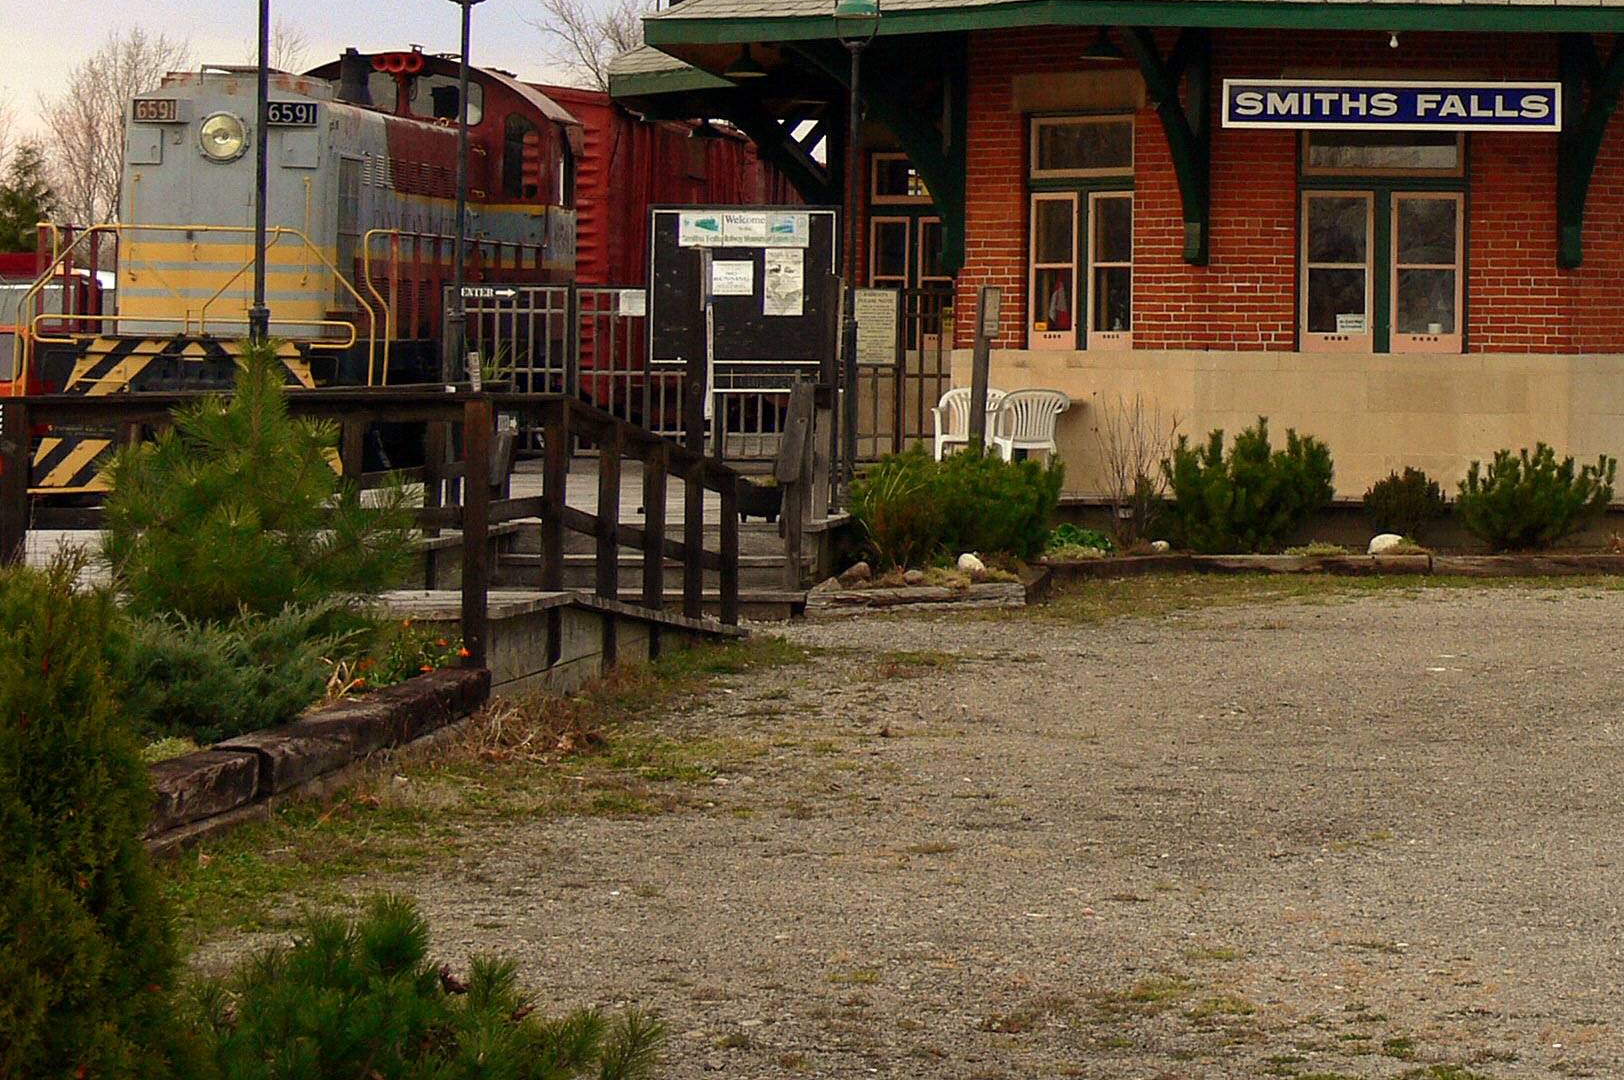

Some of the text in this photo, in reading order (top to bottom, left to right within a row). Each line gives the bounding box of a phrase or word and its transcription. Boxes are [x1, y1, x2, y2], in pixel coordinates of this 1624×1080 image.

[136, 100, 175, 120] 6591
[268, 103, 314, 124] 6591
[1234, 91, 1550, 119] SMITHS FALLS
[725, 214, 766, 225] Welcome
[460, 286, 494, 297] ENTER
